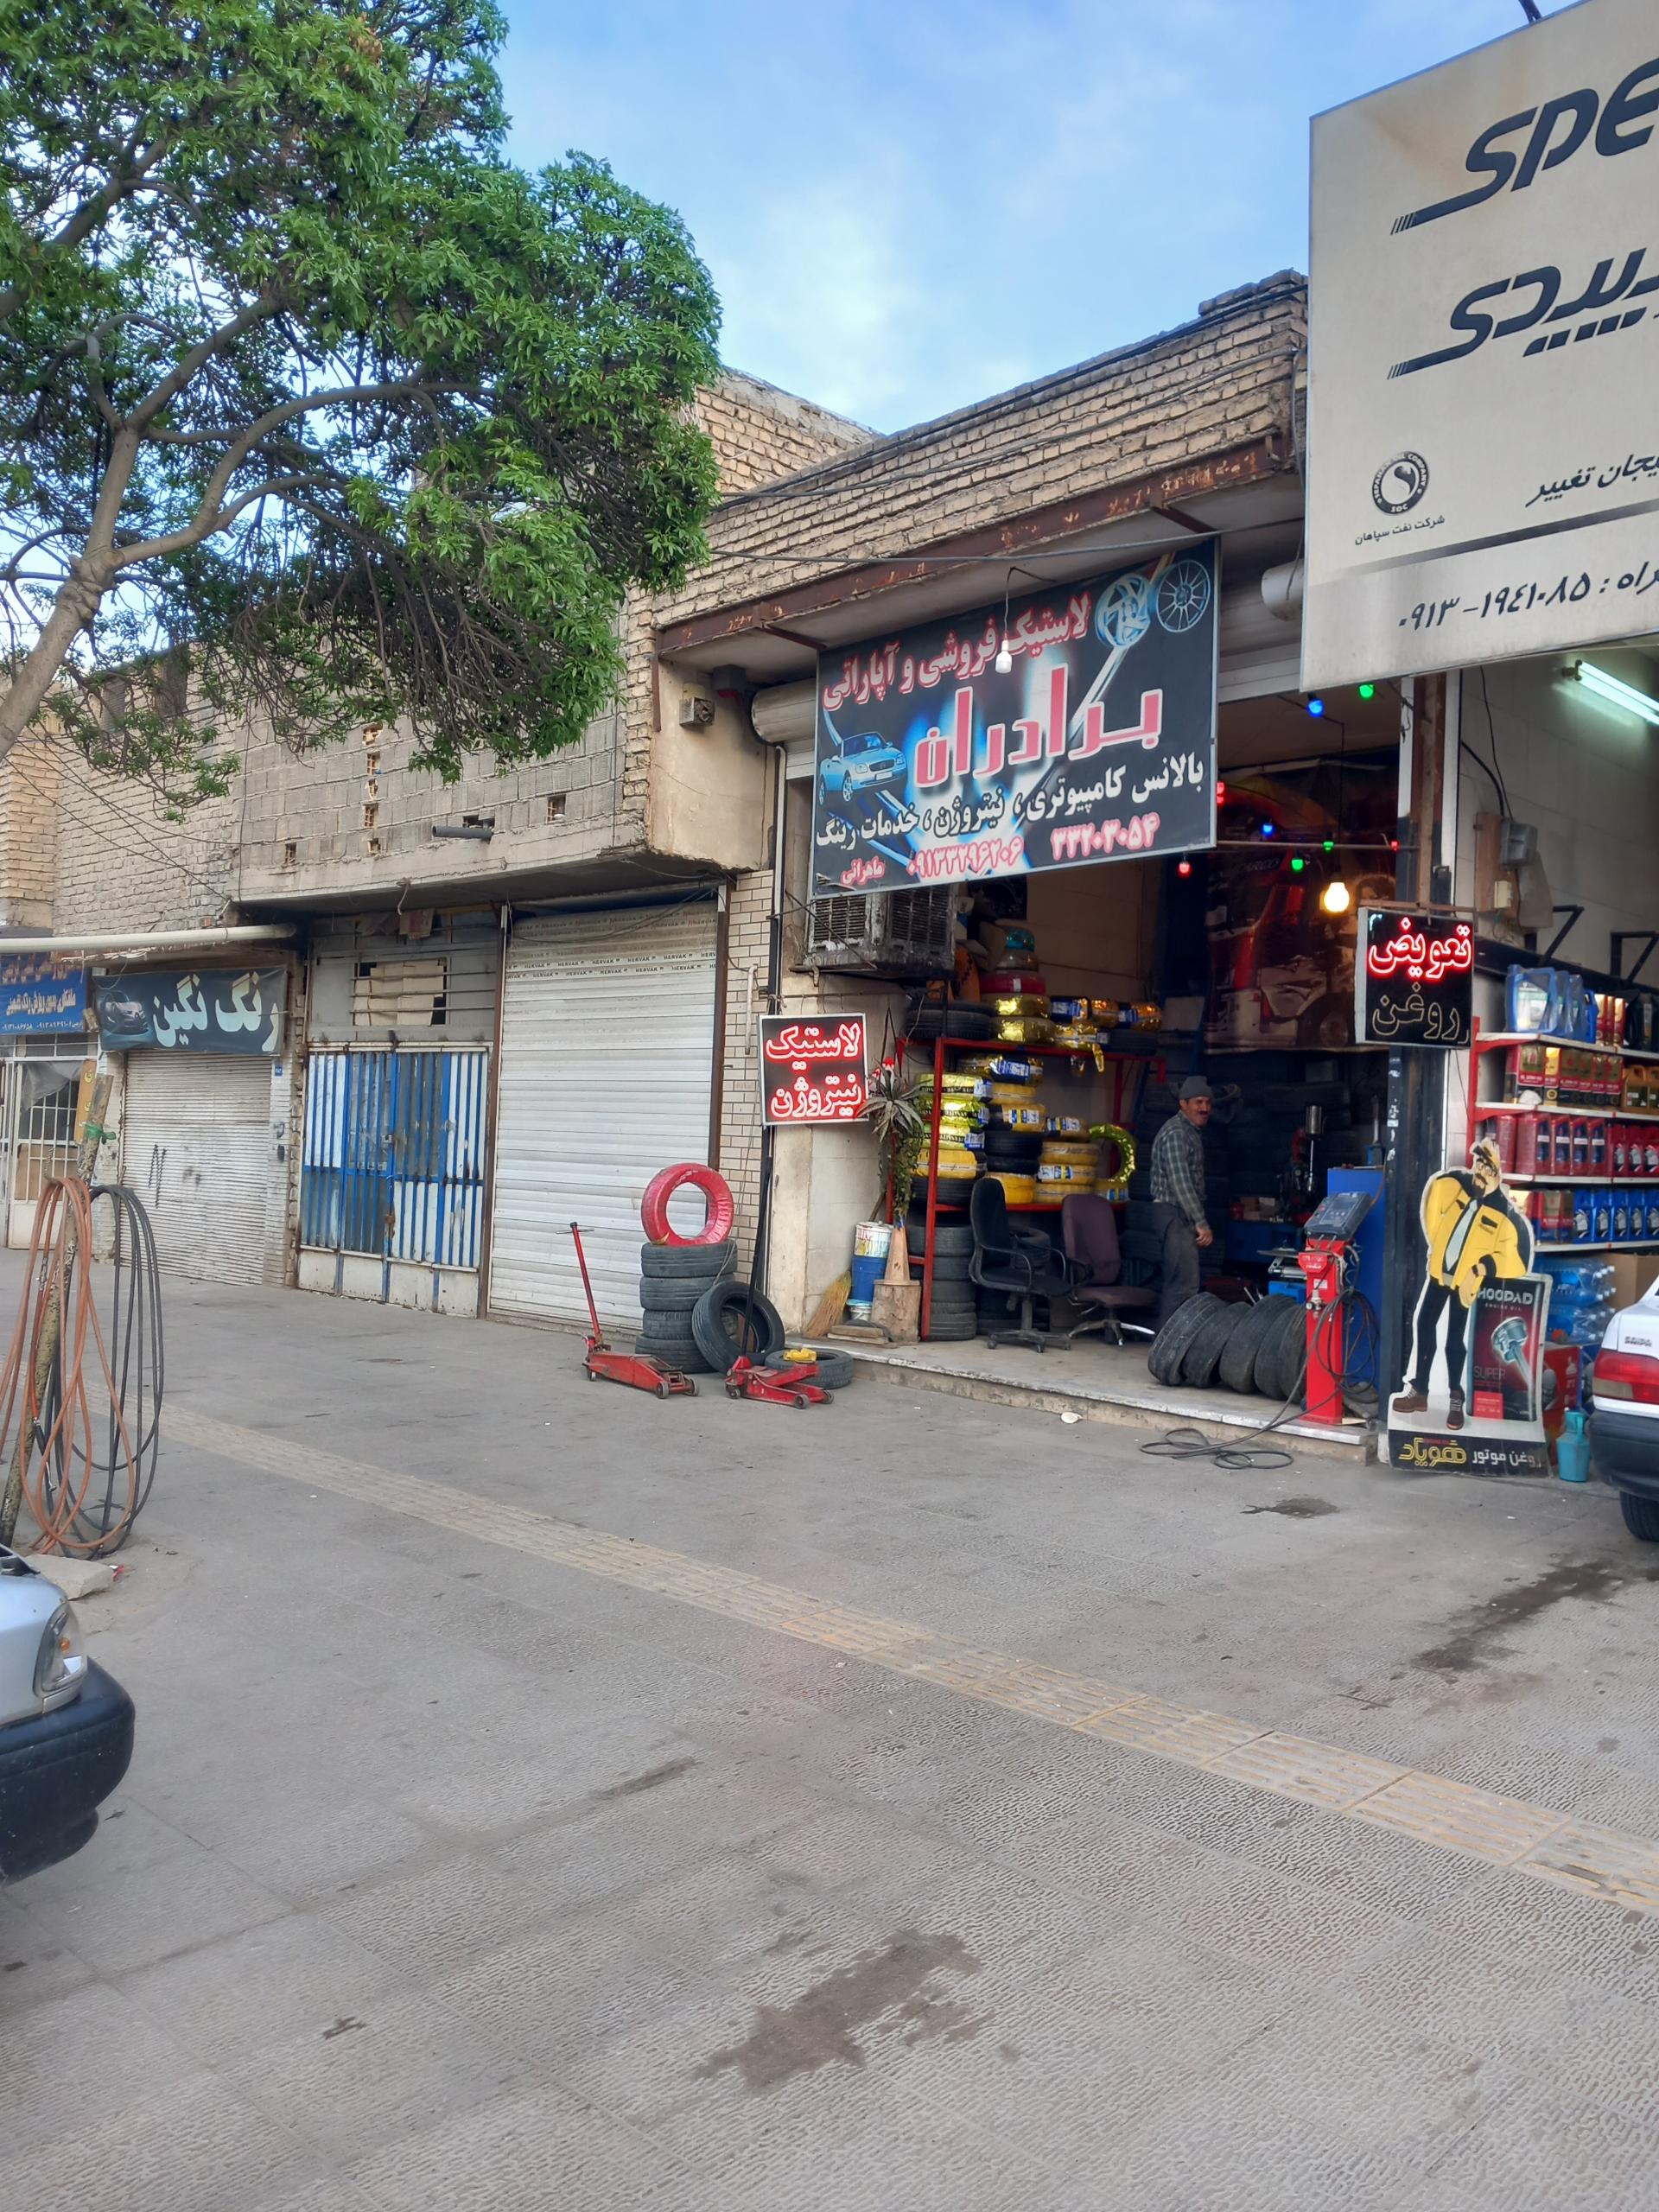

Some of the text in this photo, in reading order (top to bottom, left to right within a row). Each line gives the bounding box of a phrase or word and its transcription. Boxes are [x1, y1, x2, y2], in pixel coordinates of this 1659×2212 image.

[1525, 466, 1597, 508] تغییر
[1354, 514, 1446, 545] شرکت نفت سپاهان
[822, 590, 1092, 713] لاستیک فروشی و آپاراتی
[913, 662, 1164, 789] برادران
[1131, 751, 1205, 804] بالانس
[816, 817, 857, 850] رینگ
[861, 802, 920, 840] خدمات
[1368, 916, 1472, 980] تعویض
[152, 970, 280, 1052] رنگ نگین
[1371, 982, 1461, 1041] روغن
[766, 1022, 861, 1071] لاستیک
[770, 1072, 862, 1118] نیتروژن
[1473, 1364, 1507, 1380] SUPER
[1471, 1448, 1507, 1465] موتور
[1510, 1450, 1542, 1469] روغن
